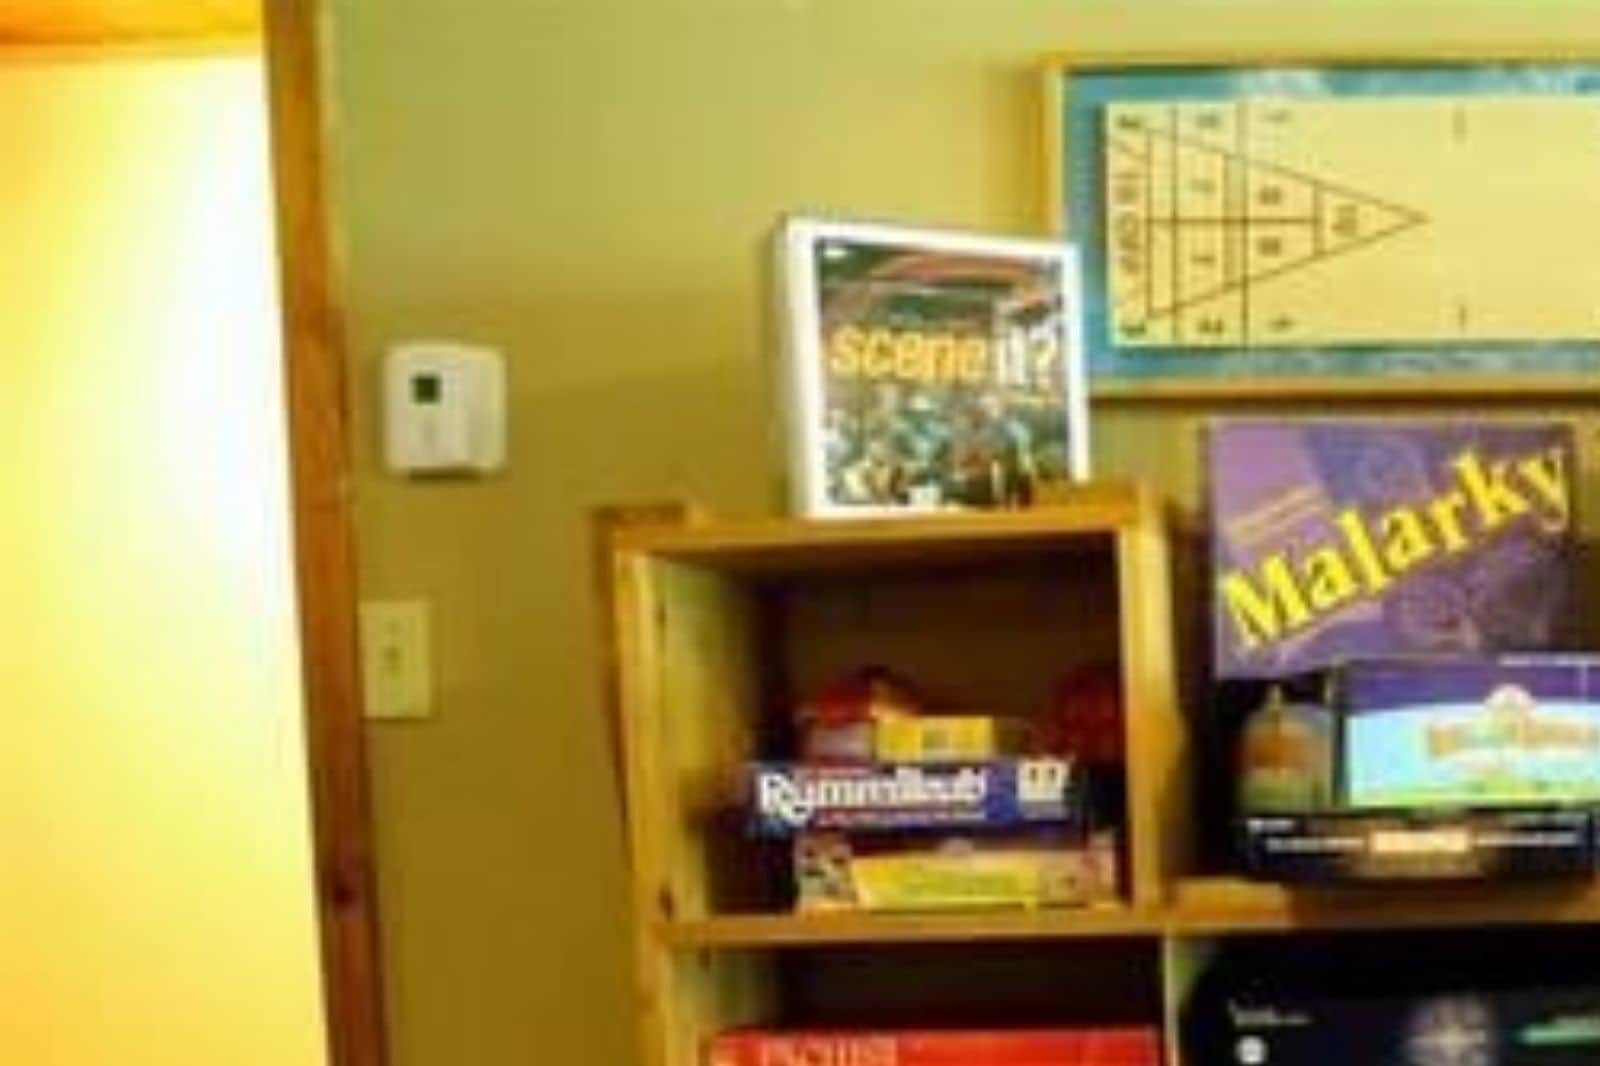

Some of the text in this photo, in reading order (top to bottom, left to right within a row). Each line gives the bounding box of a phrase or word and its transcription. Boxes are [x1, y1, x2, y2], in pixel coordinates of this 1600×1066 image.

[831, 325, 988, 382] scene
[1222, 444, 1570, 649] Malarky
[757, 764, 988, 824] Rummikub
